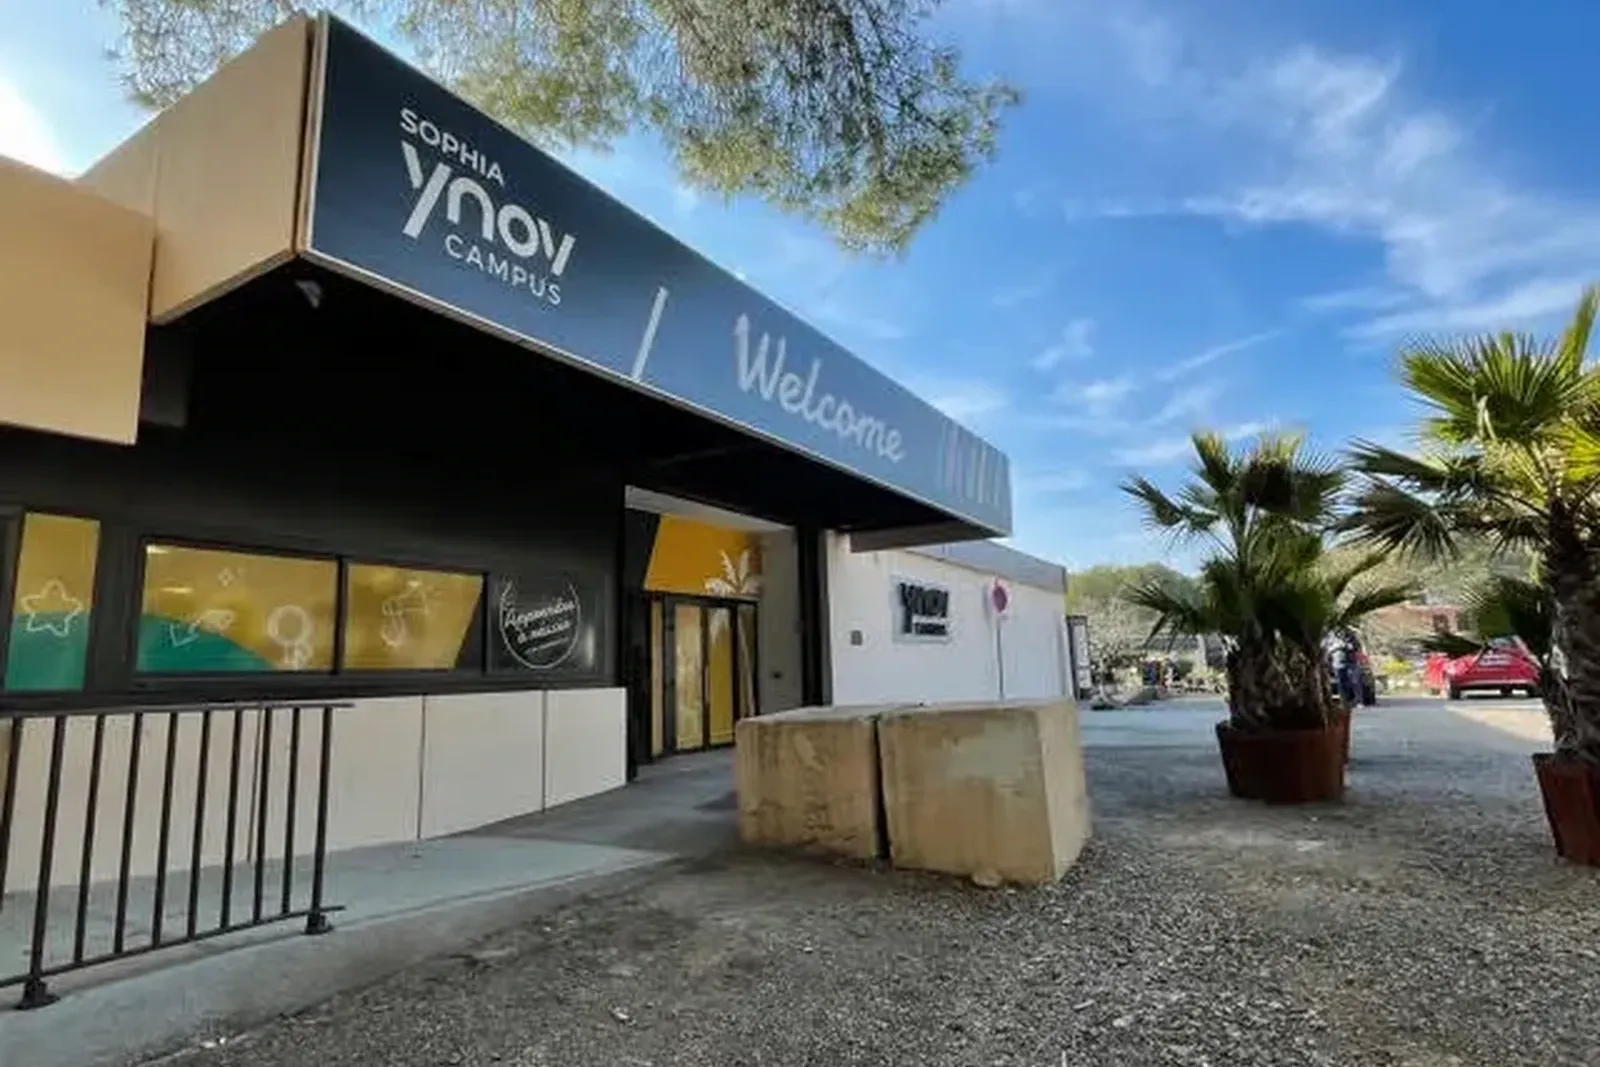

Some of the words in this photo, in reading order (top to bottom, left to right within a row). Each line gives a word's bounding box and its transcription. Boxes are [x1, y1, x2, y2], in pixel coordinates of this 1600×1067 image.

[400, 107, 505, 186] SOPHIA
[444, 233, 562, 306] CAMPUS
[734, 312, 905, 463] Welcome
